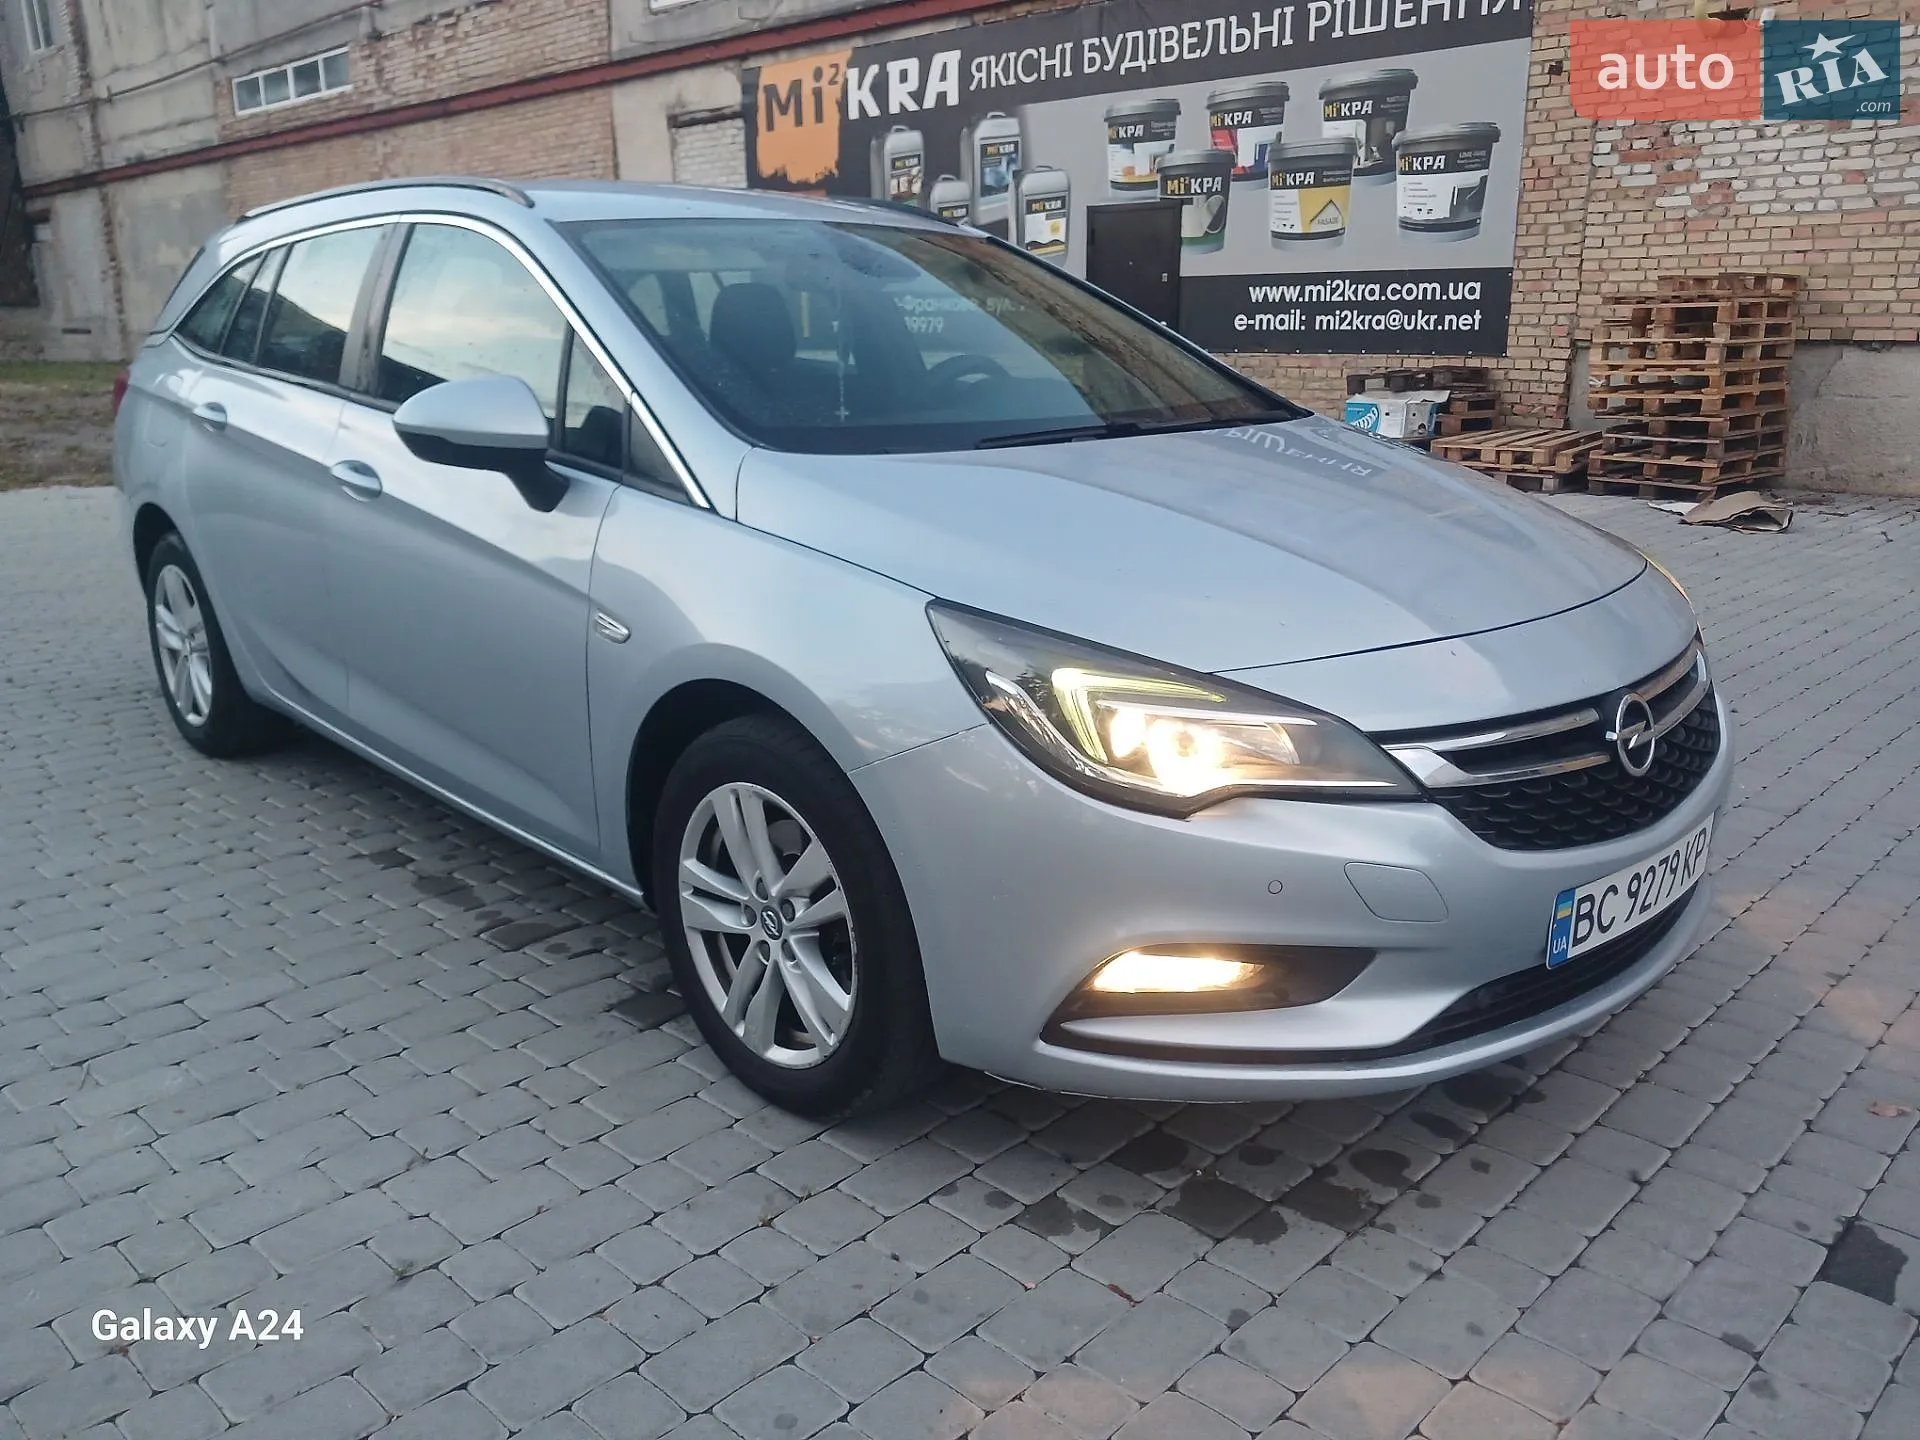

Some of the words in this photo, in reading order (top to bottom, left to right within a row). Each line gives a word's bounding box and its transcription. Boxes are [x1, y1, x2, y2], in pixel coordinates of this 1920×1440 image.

[969, 42, 1074, 91] ЯКІСНІ
[1082, 6, 1295, 75] БУДІВЕЛЬНІ
[1248, 279, 1482, 303] www.mi2kra.com.ua
[1233, 309, 1306, 331] e-mail:
[1315, 309, 1482, 331] mi2kra@ukr.net
[1572, 884, 1618, 948] BC
[1624, 850, 1681, 922] 9279
[1681, 827, 1707, 886] KP
[1552, 938, 1567, 954] UA
